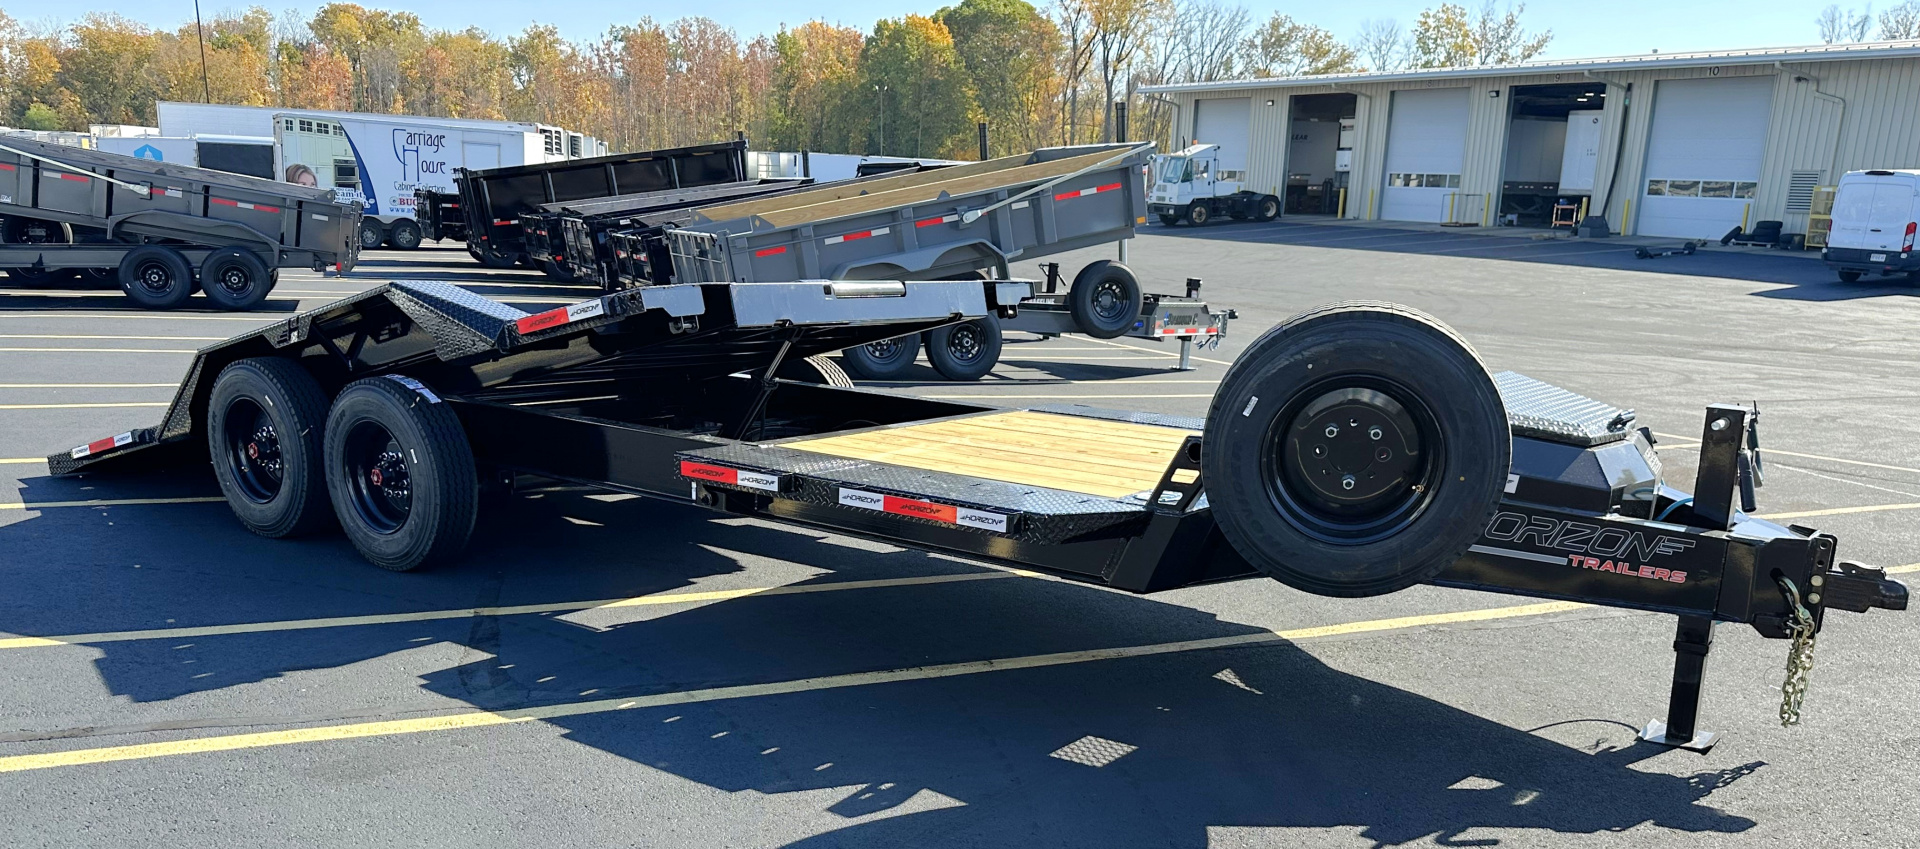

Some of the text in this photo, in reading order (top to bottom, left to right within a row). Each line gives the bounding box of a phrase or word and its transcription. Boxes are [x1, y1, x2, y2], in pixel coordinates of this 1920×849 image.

[1555, 73, 1561, 82] 9
[1708, 66, 1720, 76] 10
[393, 128, 446, 167] Carriage
[402, 145, 446, 182] House
[393, 181, 416, 192] Cabinet
[531, 304, 598, 327] HORIZON HORIZON
[694, 468, 774, 486] HORIZON HORIZON
[845, 494, 1002, 525] HORIZON HORIZON HORIZON
[1484, 510, 1666, 562] ORIZON
[1568, 554, 1688, 584] TRAILERS
